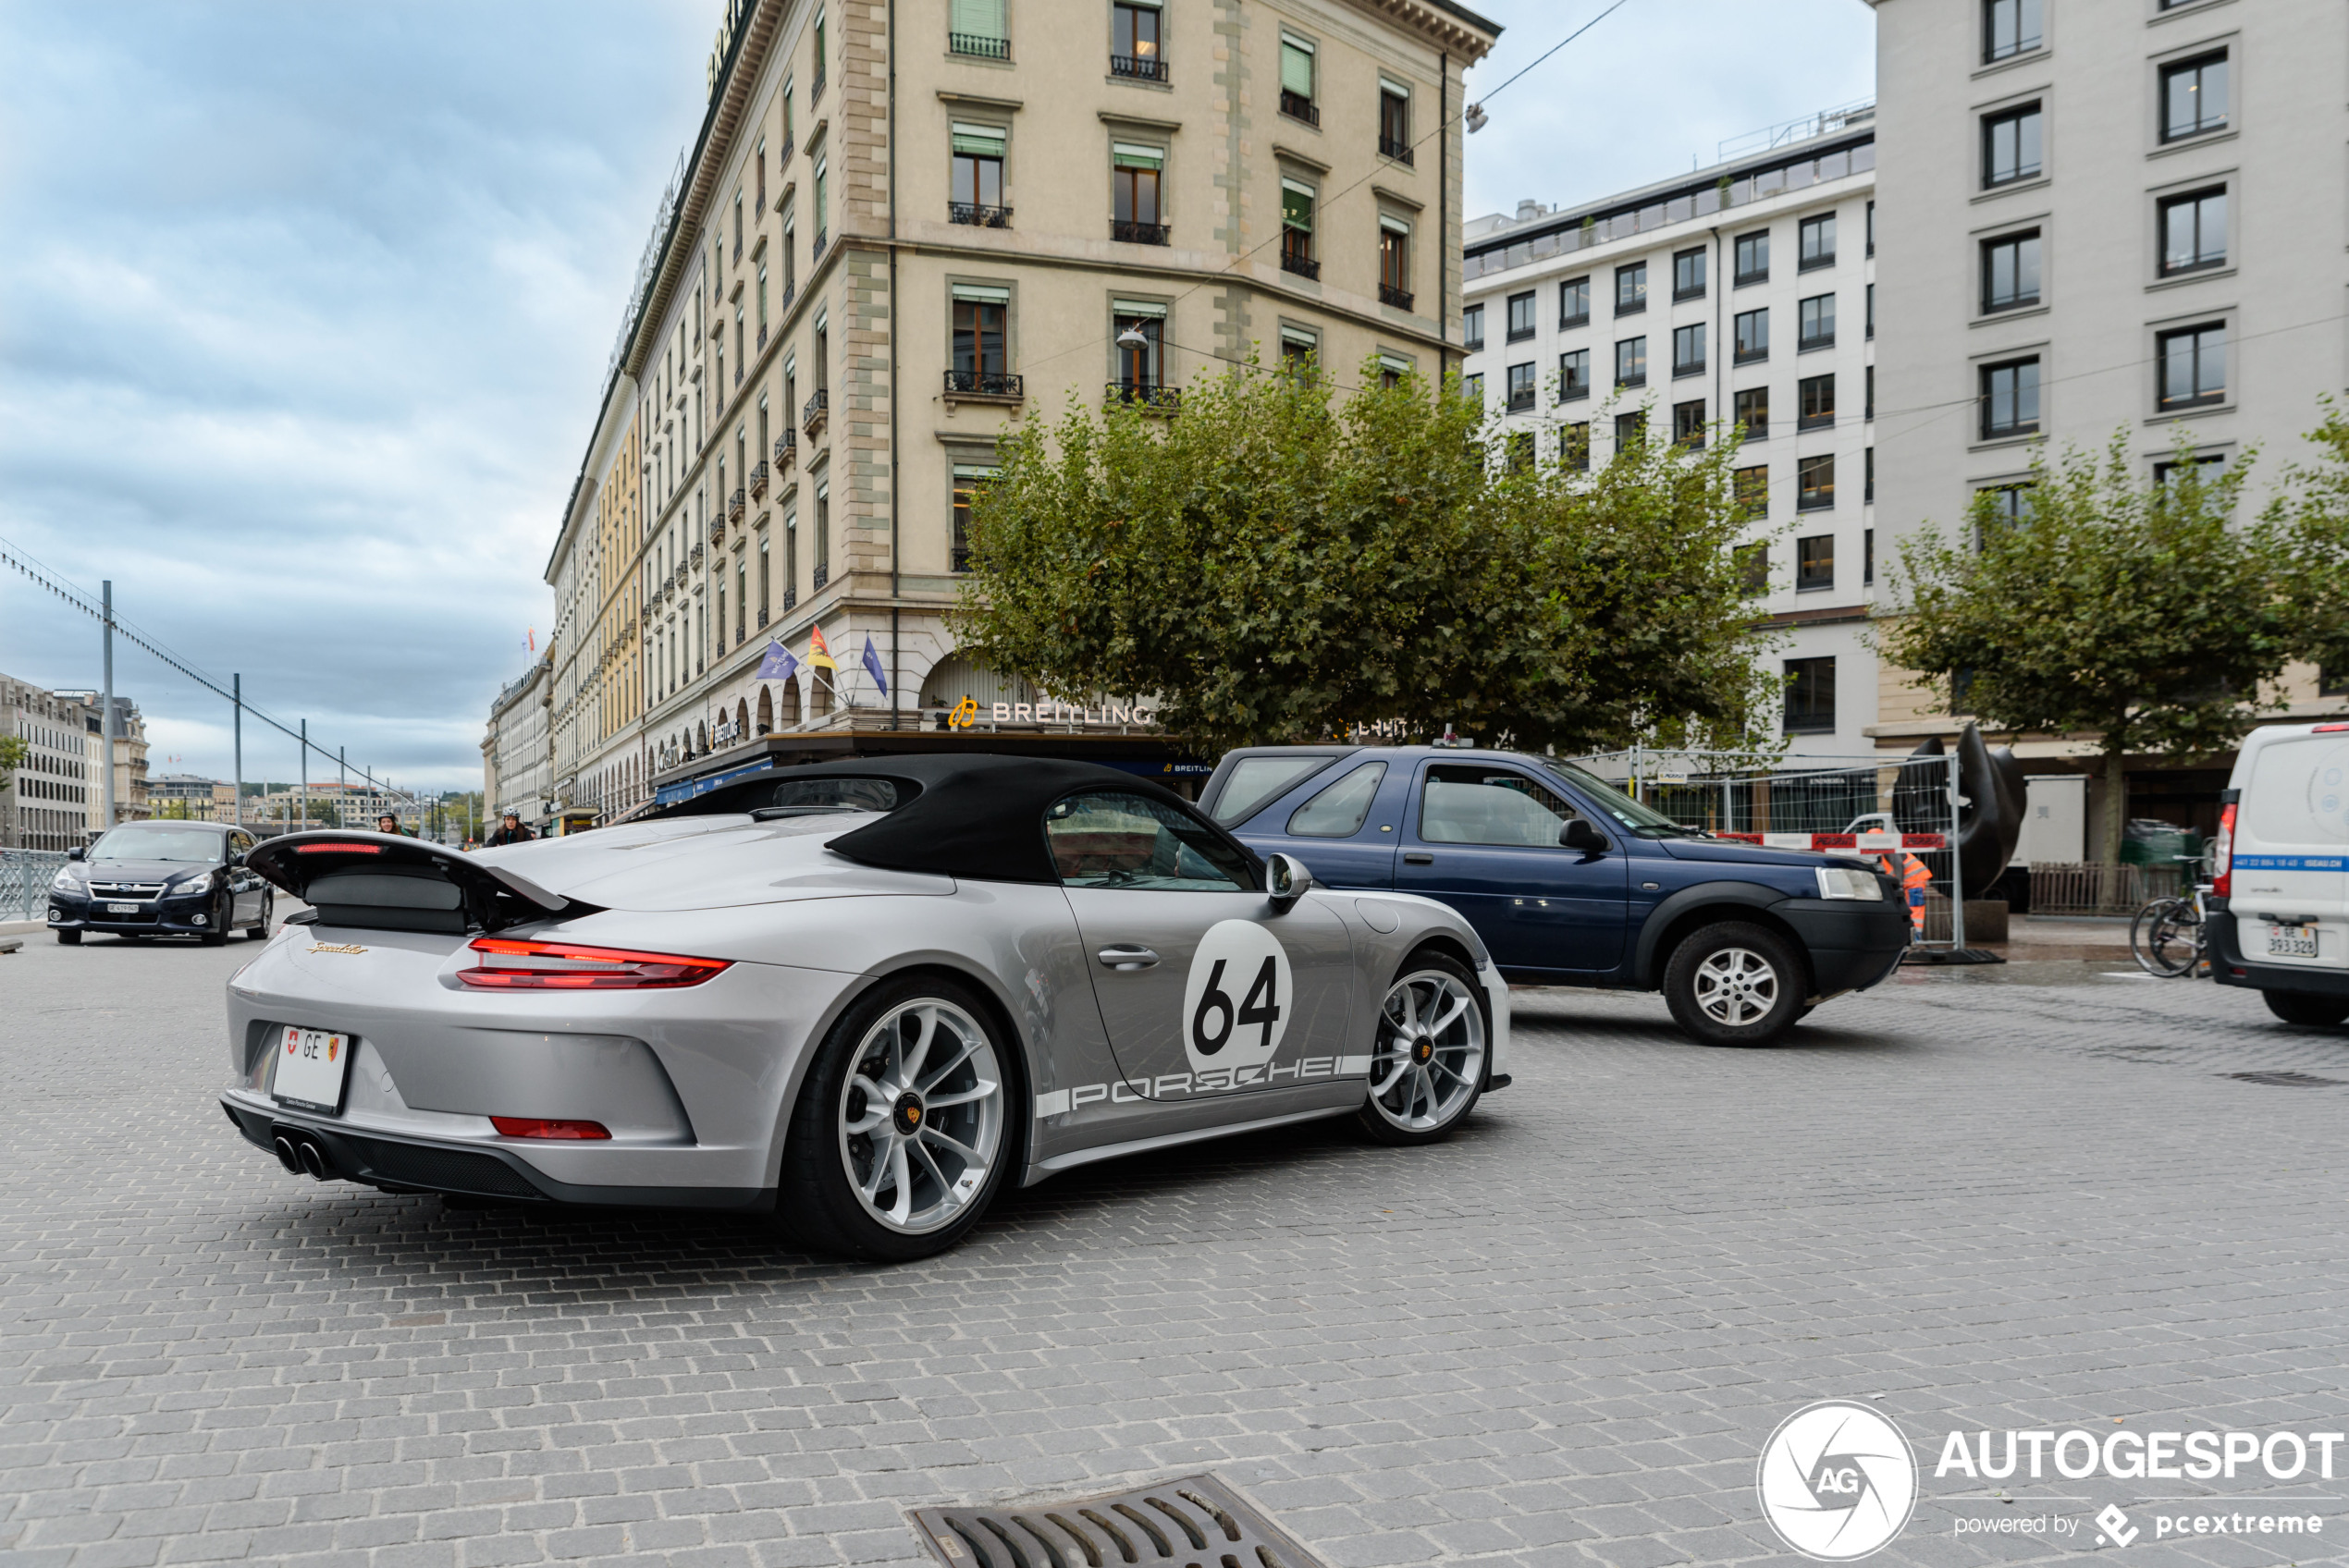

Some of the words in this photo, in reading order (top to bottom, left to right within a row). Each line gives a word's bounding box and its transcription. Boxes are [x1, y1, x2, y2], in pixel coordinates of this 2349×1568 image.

[991, 703, 1150, 724] BREITLING
[305, 941, 369, 954] Speedster
[2270, 938, 2291, 951] 393
[1192, 955, 1281, 1056] 64
[303, 1034, 321, 1060] GE
[1072, 1056, 1334, 1110] PORSCHE
